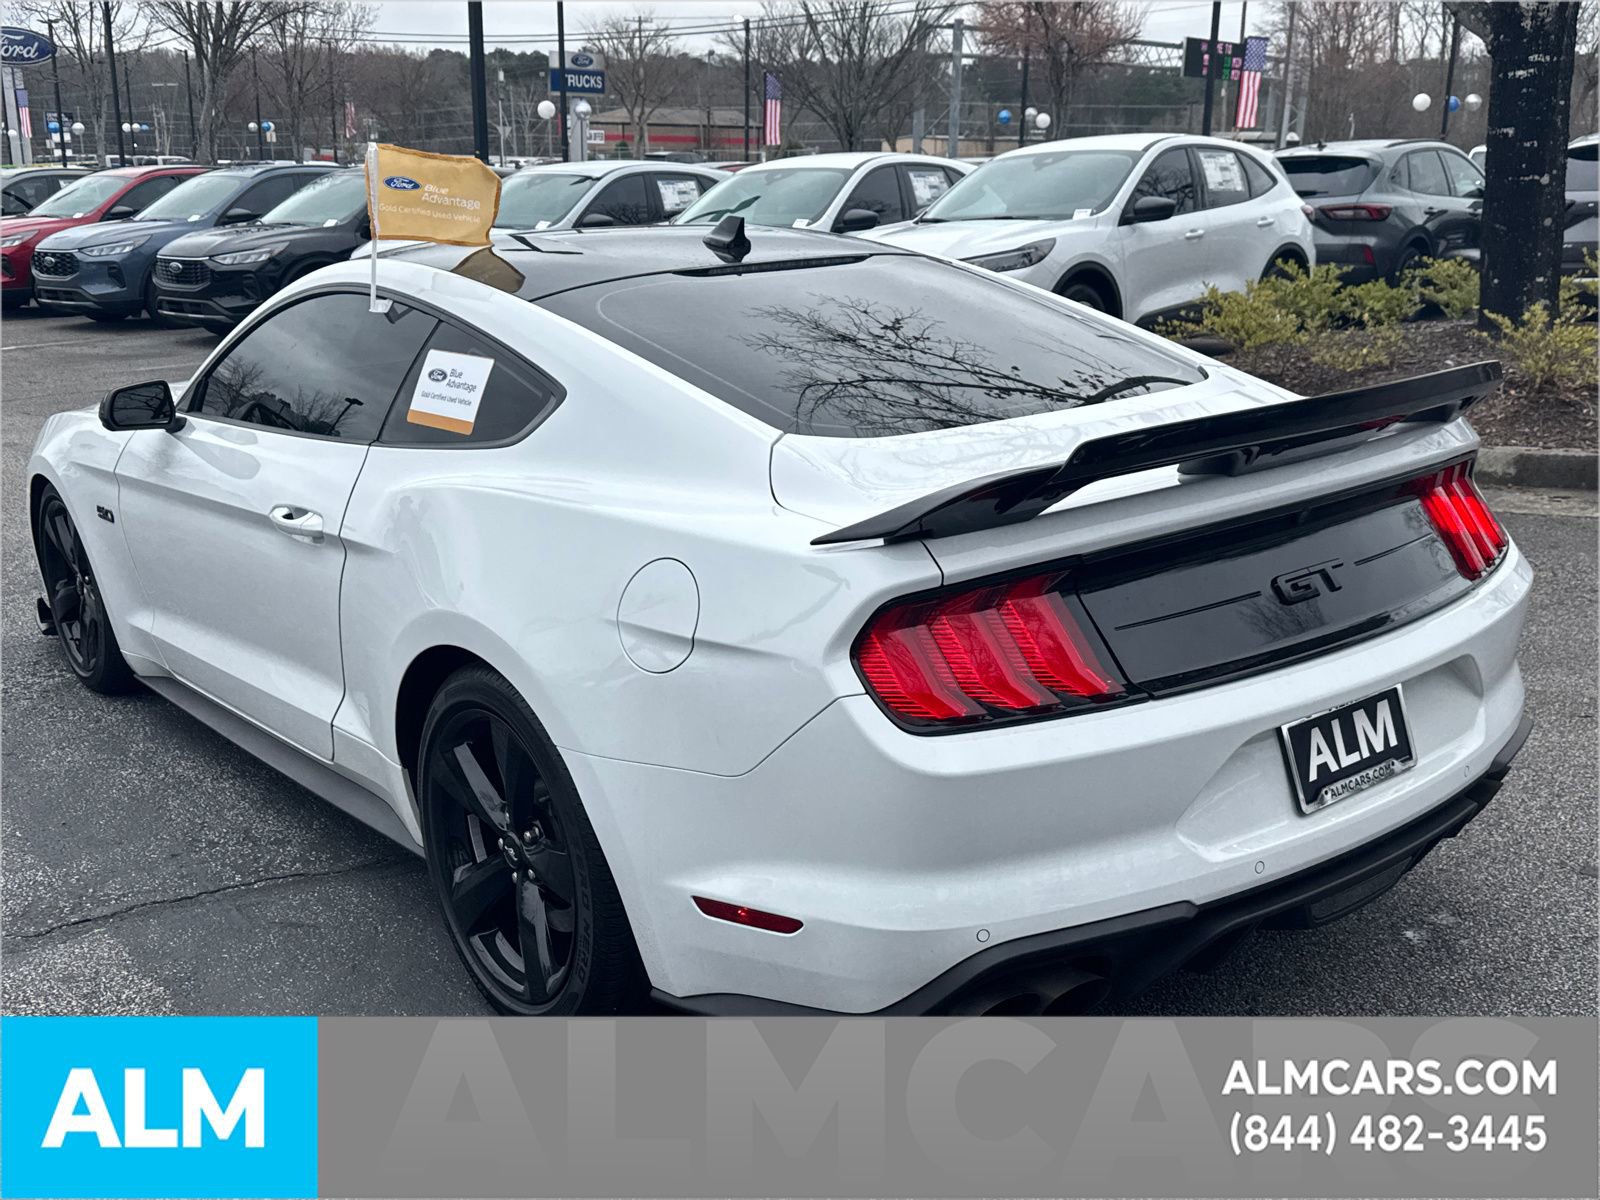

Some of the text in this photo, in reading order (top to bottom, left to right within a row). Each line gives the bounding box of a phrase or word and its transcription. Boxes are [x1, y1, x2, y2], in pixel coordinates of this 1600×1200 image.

[390, 177, 415, 189] Ford
[424, 183, 449, 195] Blue
[421, 192, 481, 210] Advantage
[379, 202, 480, 224] Gold Certified Used Vehicle
[449, 368, 464, 379] Blue
[445, 378, 477, 394] Advantage
[421, 390, 472, 407] Gold Certified Used Vehicle
[1270, 558, 1344, 606] GT
[1308, 698, 1399, 783] ALM
[1329, 763, 1392, 799] ALMCARS.COM
